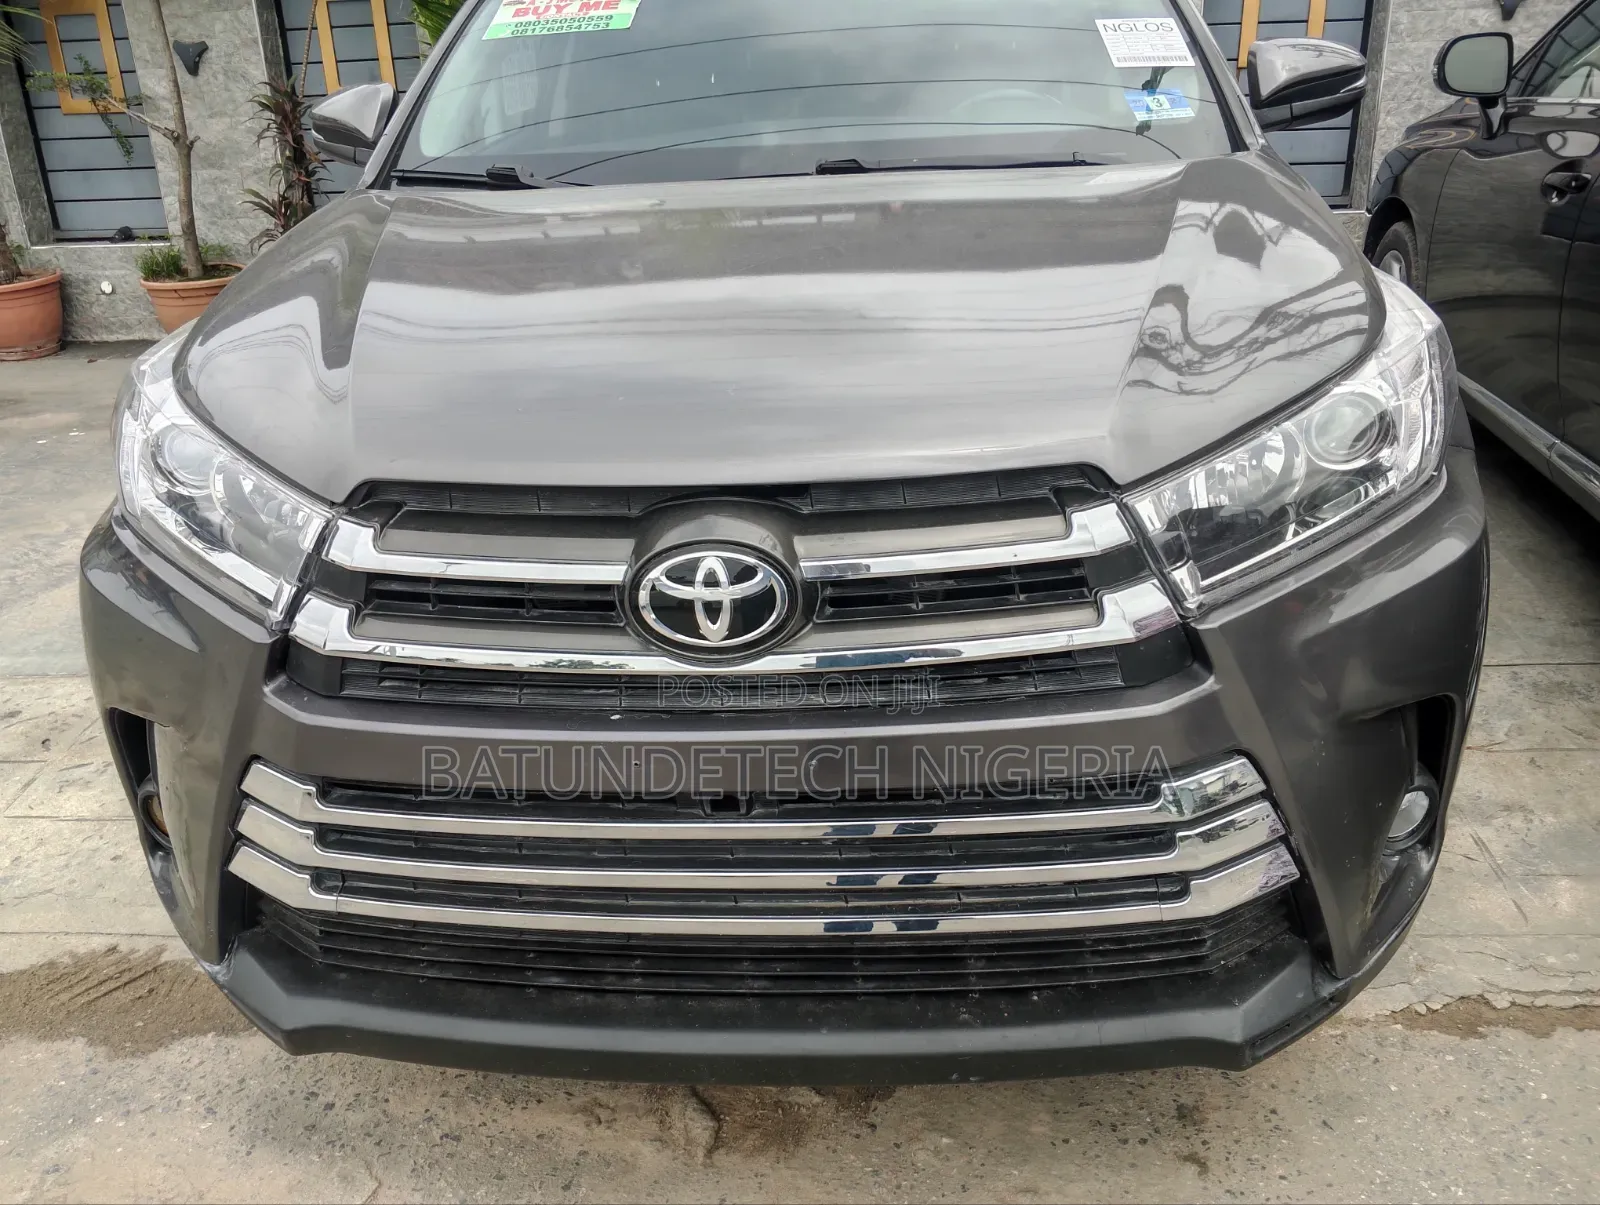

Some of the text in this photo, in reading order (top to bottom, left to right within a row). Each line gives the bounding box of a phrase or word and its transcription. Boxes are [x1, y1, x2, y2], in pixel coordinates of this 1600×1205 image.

[512, 3, 573, 18] BUY
[577, 0, 620, 12] ME
[514, 15, 614, 28] 08035050559
[1102, 22, 1174, 33] NGLOS
[510, 22, 610, 36] 08176854753
[1152, 97, 1163, 108] 3
